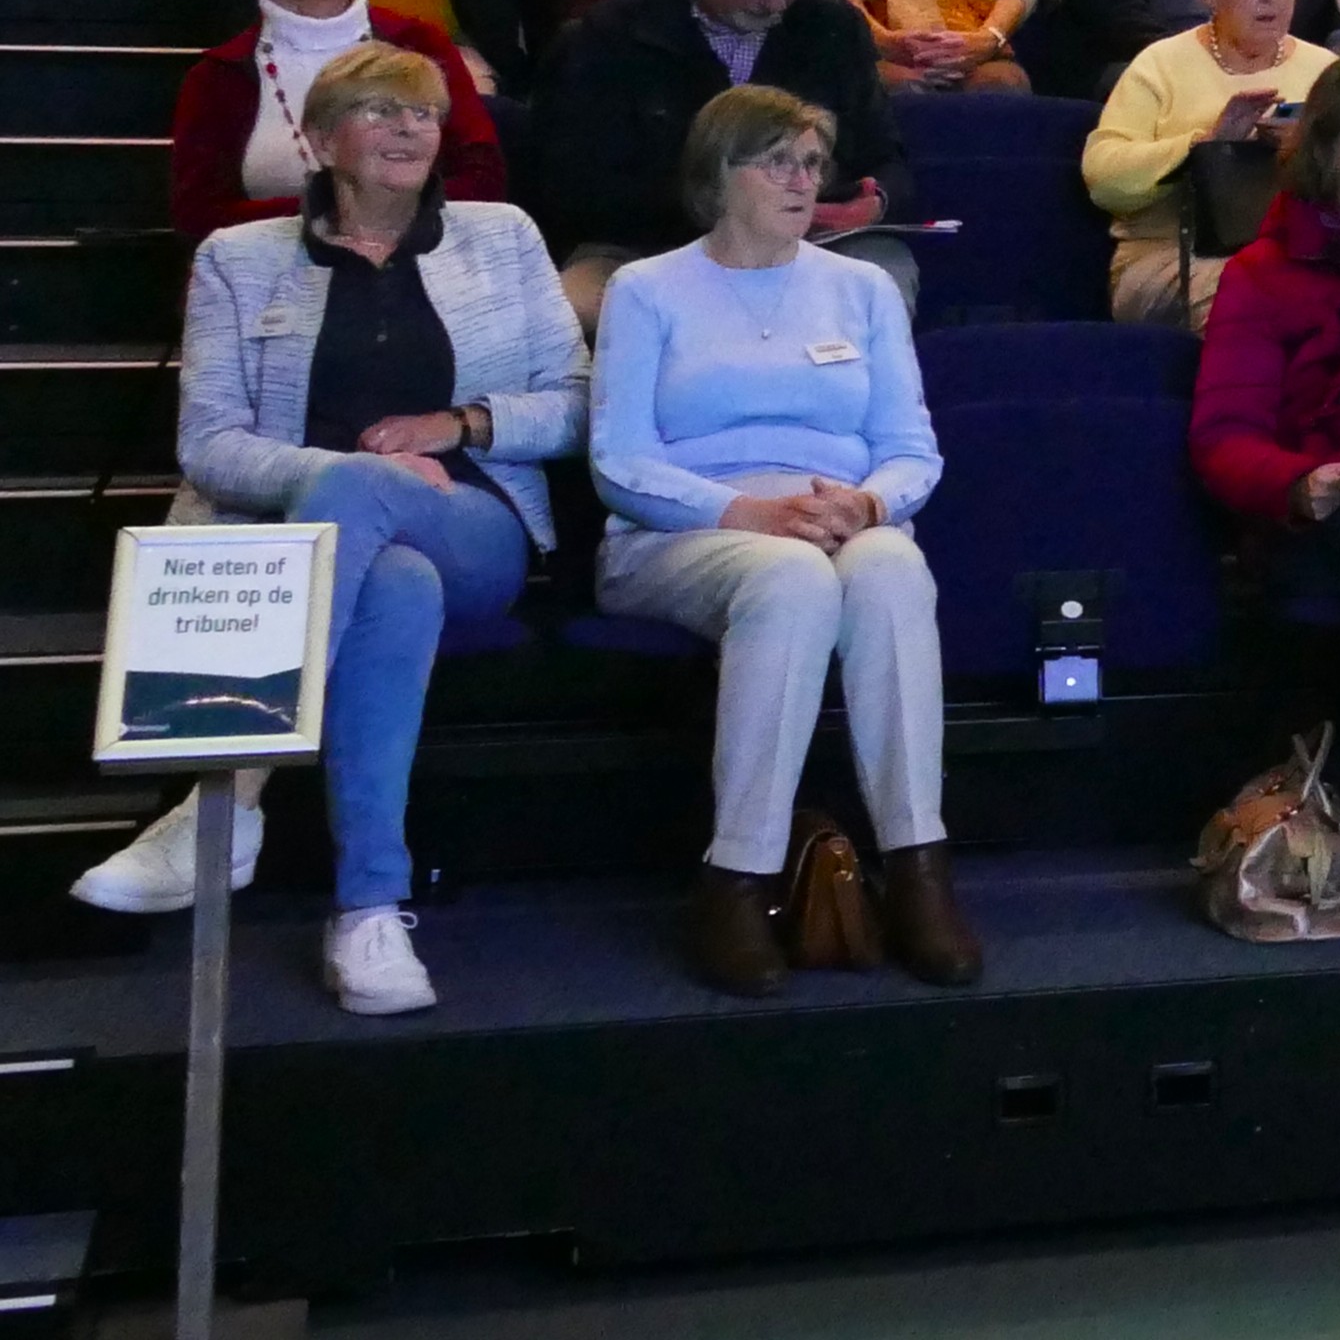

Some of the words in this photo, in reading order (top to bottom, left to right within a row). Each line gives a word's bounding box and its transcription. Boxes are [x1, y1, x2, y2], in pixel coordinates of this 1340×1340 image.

[163, 558, 205, 576] Niet
[212, 559, 258, 576] eten
[265, 557, 287, 575] of
[148, 585, 229, 606] drinken
[236, 588, 261, 607] op
[268, 585, 293, 604] de
[175, 613, 259, 634] tribune!
